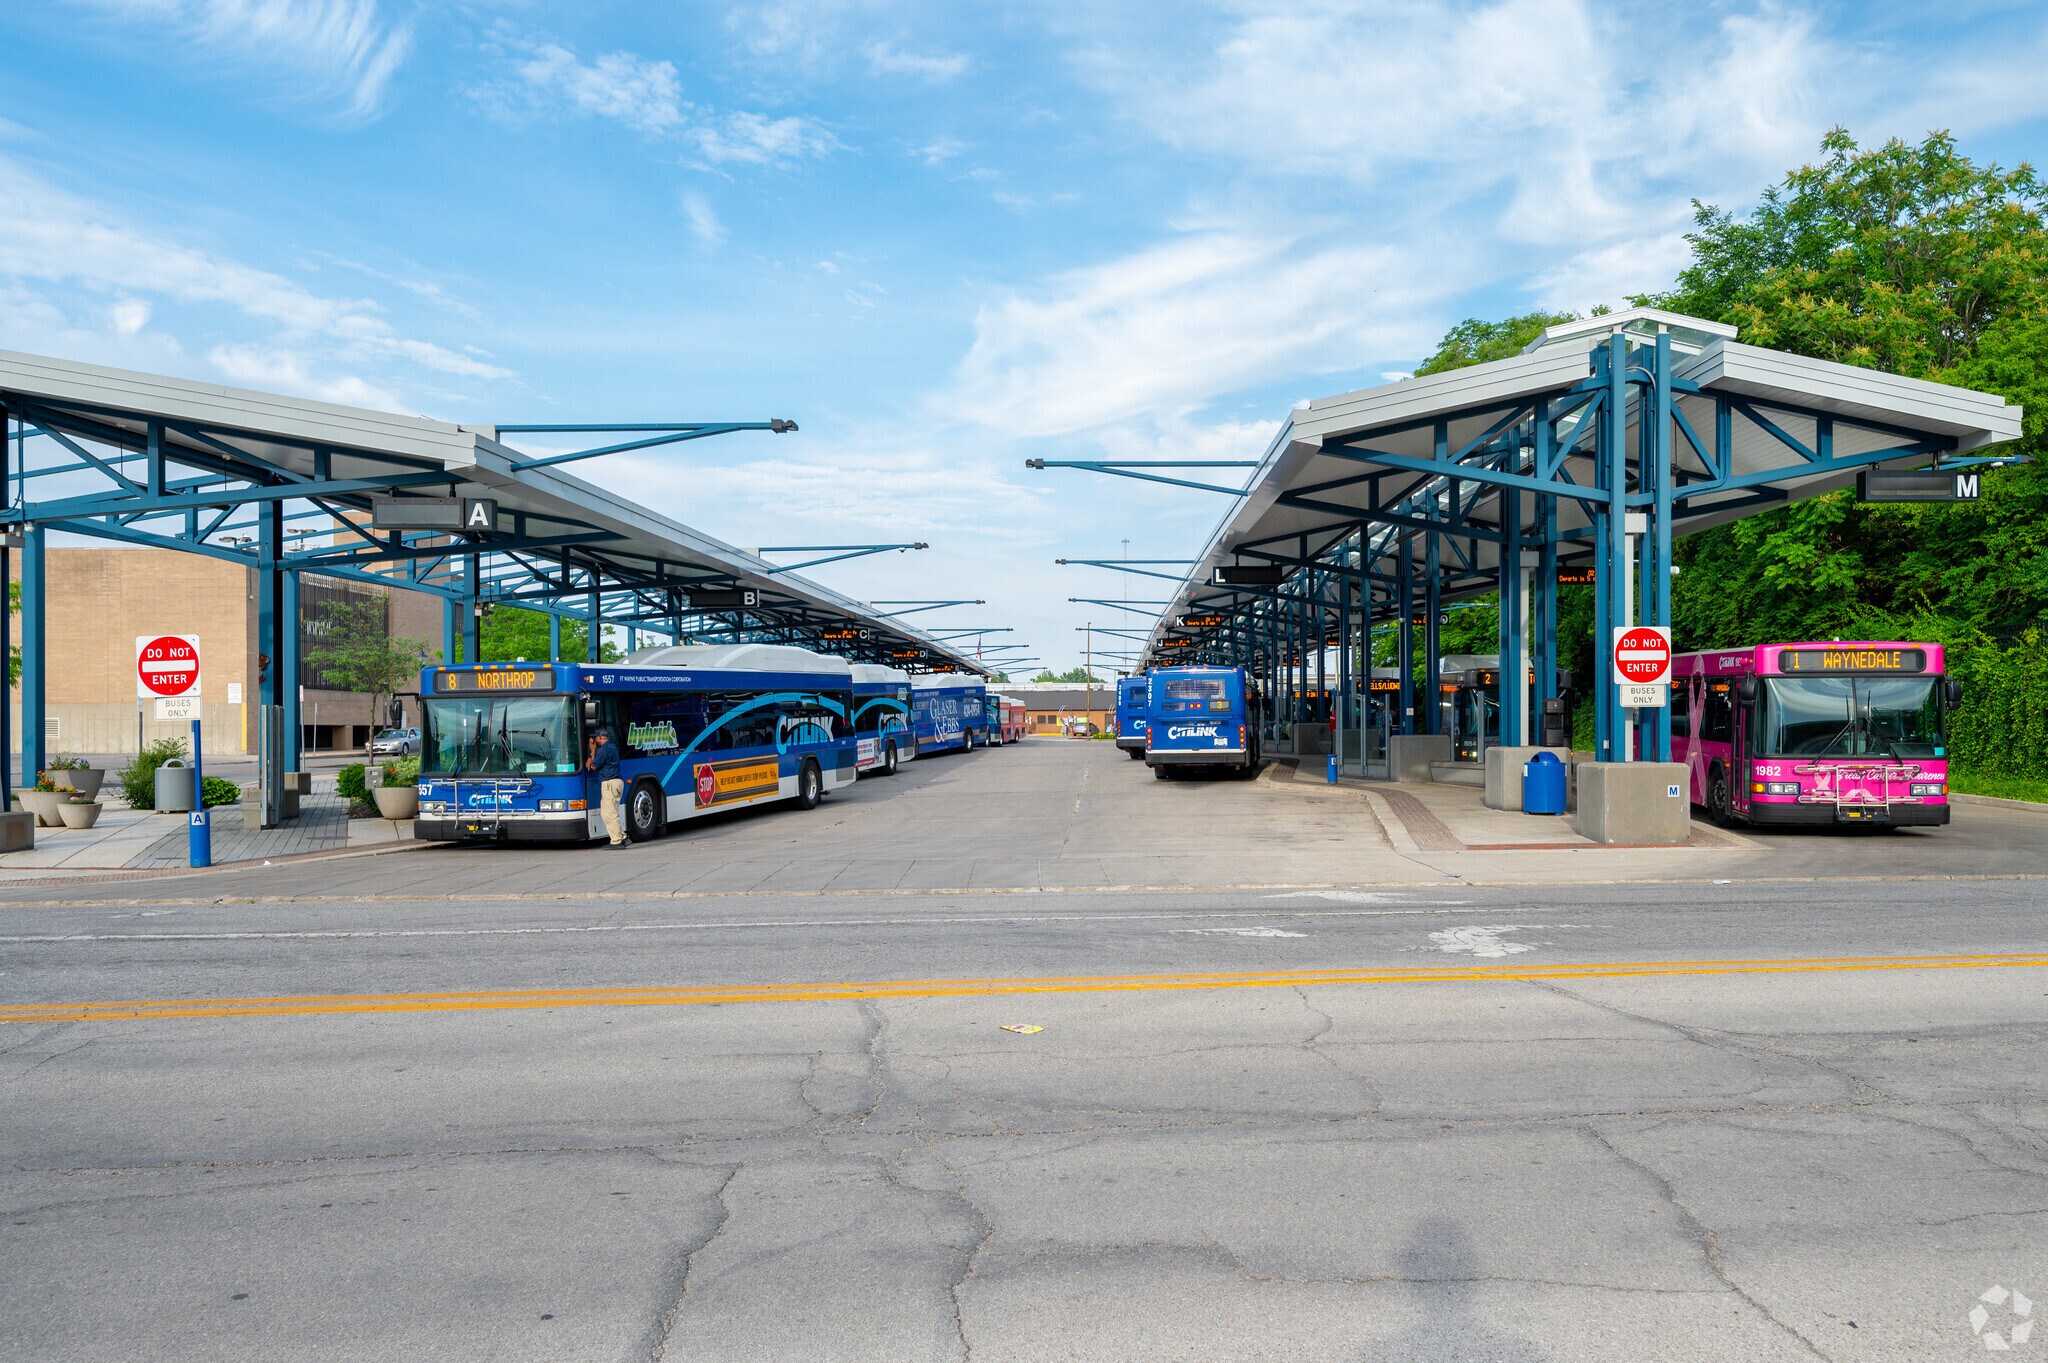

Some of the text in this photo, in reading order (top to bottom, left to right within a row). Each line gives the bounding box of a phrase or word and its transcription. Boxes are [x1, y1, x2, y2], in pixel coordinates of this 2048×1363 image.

[1957, 474, 1978, 498] M
[468, 502, 489, 526] A
[1215, 568, 1226, 583] L
[743, 591, 756, 605] B
[1176, 616, 1185, 627] K
[859, 629, 868, 639] C
[1157, 639, 1164, 647] J
[1623, 638, 1662, 648] DO NOT
[147, 647, 190, 658] DO NOT
[919, 650, 926, 658] D
[1793, 651, 1901, 669] 1 WAYNEDALE
[1626, 663, 1659, 672] ENTER
[152, 674, 187, 685] ENTER
[448, 671, 536, 690] 8 NORTHROP
[601, 675, 615, 684] 1557
[1485, 673, 1491, 685] 2
[165, 699, 191, 708] BUSES
[929, 697, 958, 720] GLASER
[1217, 701, 1223, 709] 3
[168, 709, 189, 717] ONLY
[1755, 765, 1781, 777] 1982
[700, 776, 713, 793] STOP
[1669, 786, 1678, 796] M
[193, 814, 203, 824] A
